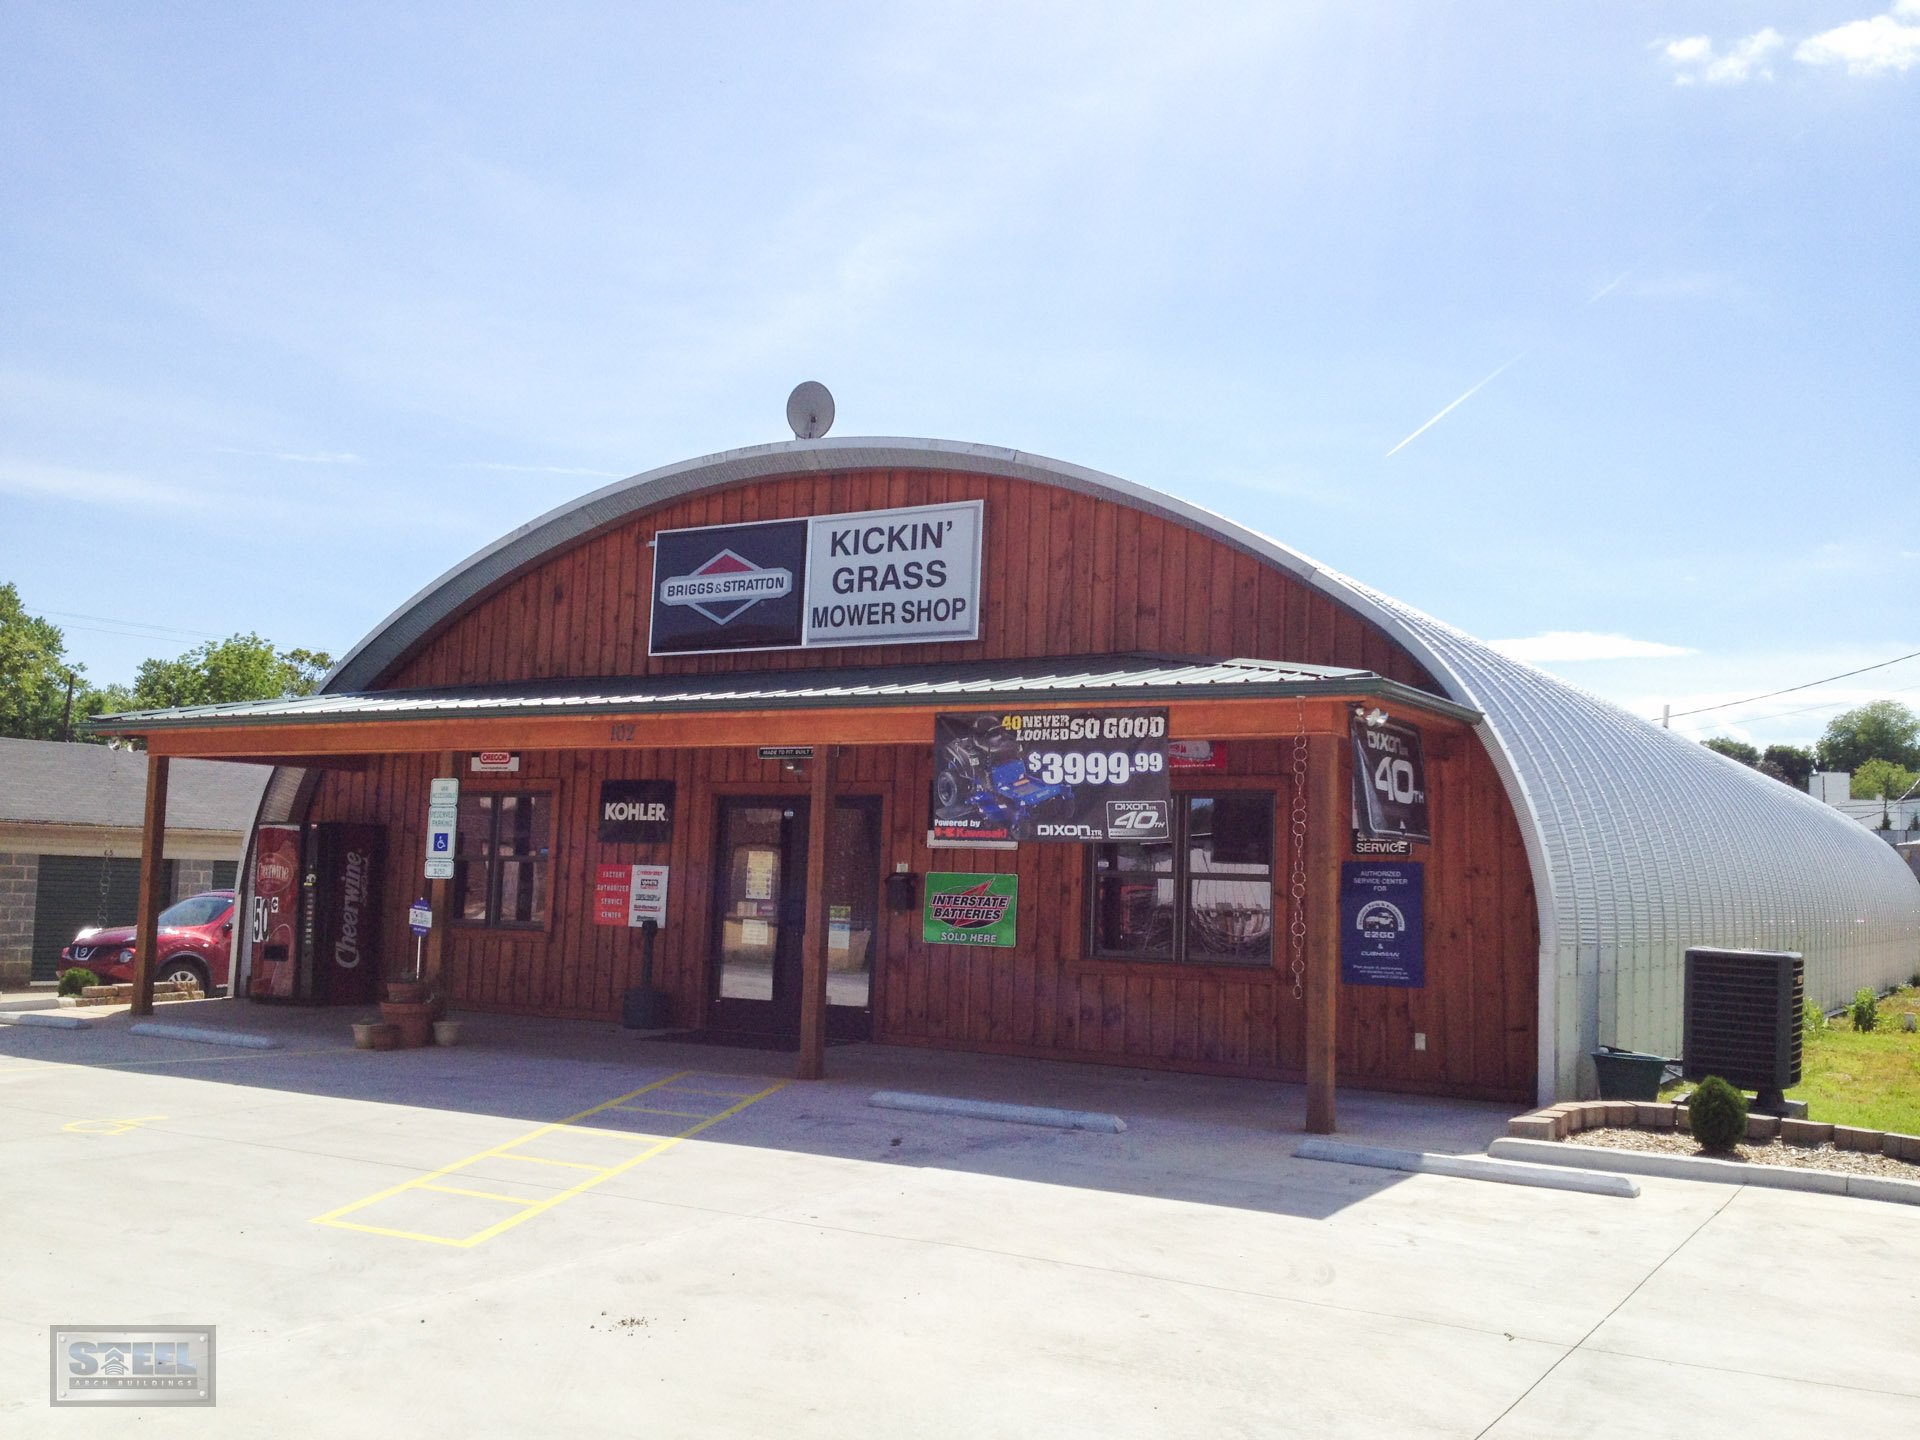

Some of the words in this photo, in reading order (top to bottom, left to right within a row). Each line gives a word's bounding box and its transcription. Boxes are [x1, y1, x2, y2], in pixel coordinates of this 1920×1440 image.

[830, 521, 953, 557] KICKIN'
[832, 560, 947, 594] GRASS
[812, 603, 896, 628] MOWER
[901, 598, 966, 624] SHOP
[1002, 716, 1022, 730] 40
[1022, 715, 1070, 728] NEVER
[1069, 718, 1100, 739] SO
[1103, 716, 1165, 738] GOOD
[1016, 728, 1069, 741] LOOKED
[1366, 730, 1401, 753] DIXON
[605, 802, 666, 822] KOHLER
[934, 819, 968, 827] Powered
[970, 819, 981, 828] by
[1037, 825, 1091, 836] DIXON
[1356, 842, 1406, 853] SERVICE
[597, 884, 629, 892] AUTHORIZED
[932, 895, 1008, 907] INTERSTATE
[335, 851, 363, 968] Cheerwine
[933, 908, 1001, 919] BATTERIES
[941, 932, 967, 941] SOLD
[969, 934, 997, 943] HERE
